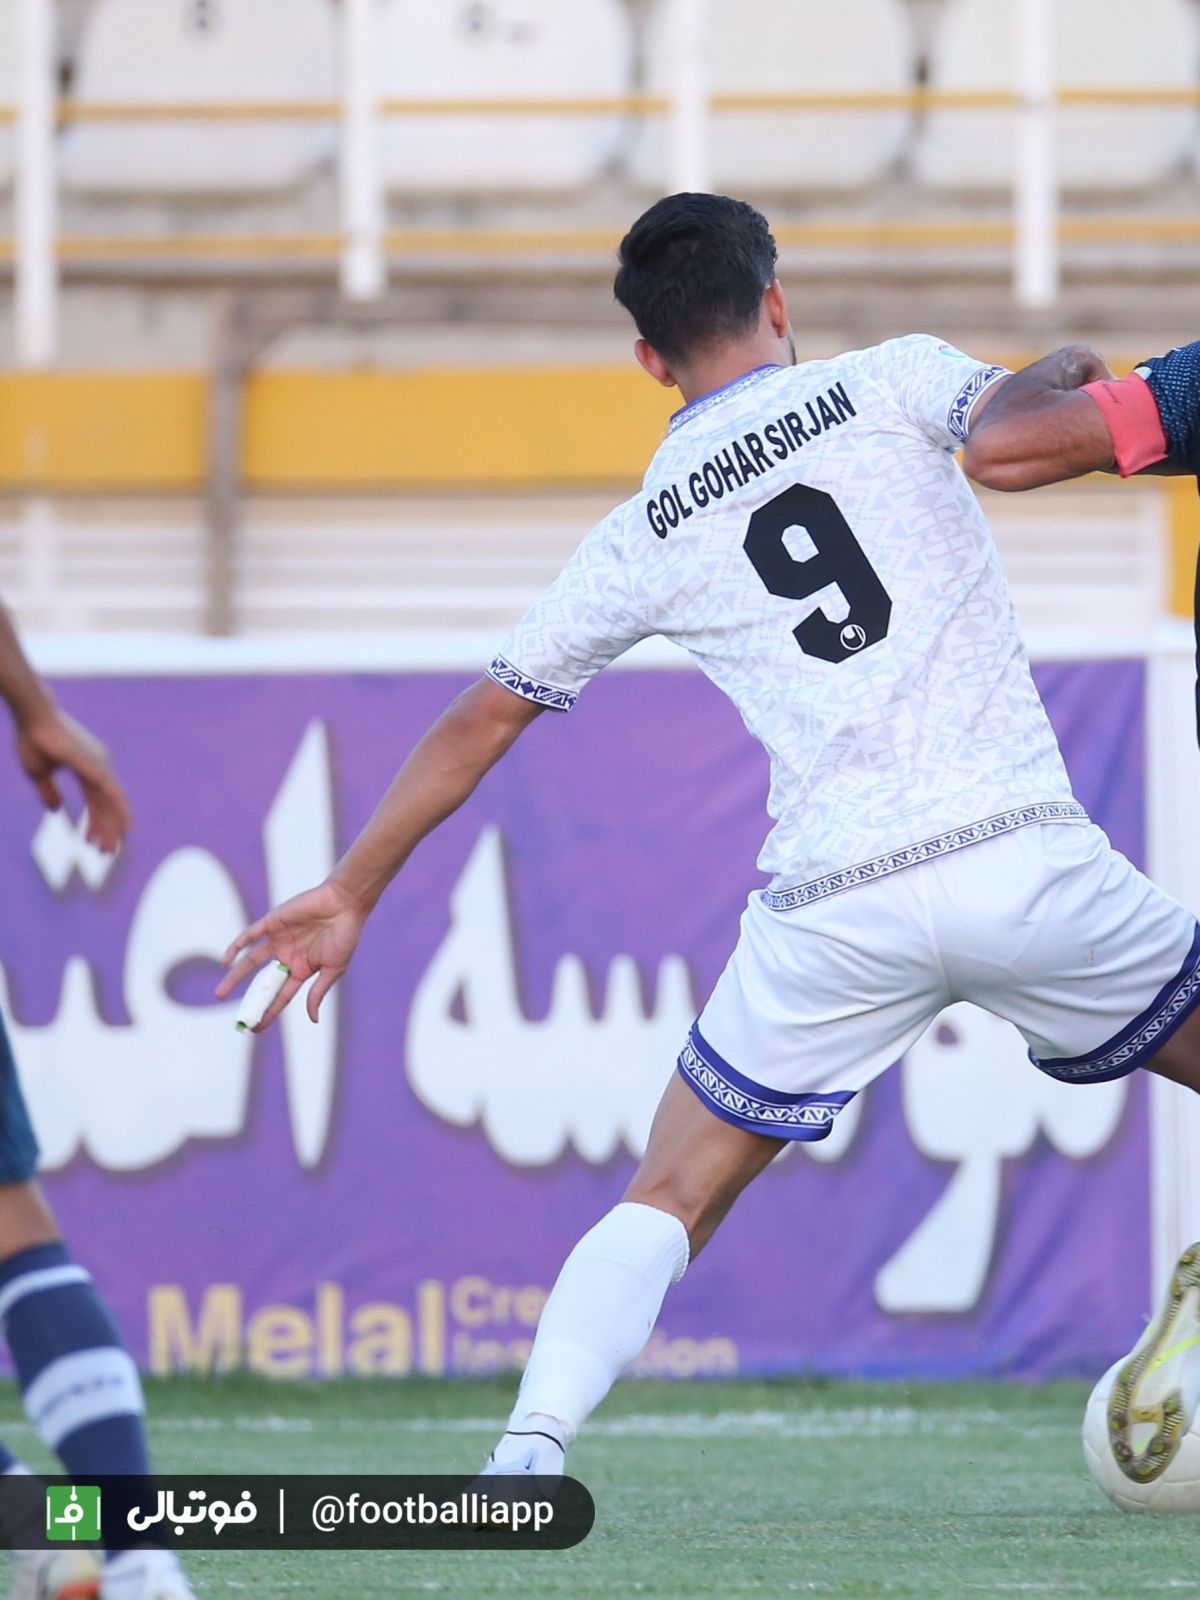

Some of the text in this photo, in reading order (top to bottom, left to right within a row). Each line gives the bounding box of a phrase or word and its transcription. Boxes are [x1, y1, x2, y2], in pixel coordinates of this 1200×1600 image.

[646, 381, 858, 540] GOL GOHAR SIRJAN
[743, 482, 893, 664] 9
[147, 1279, 446, 1377] Melal
